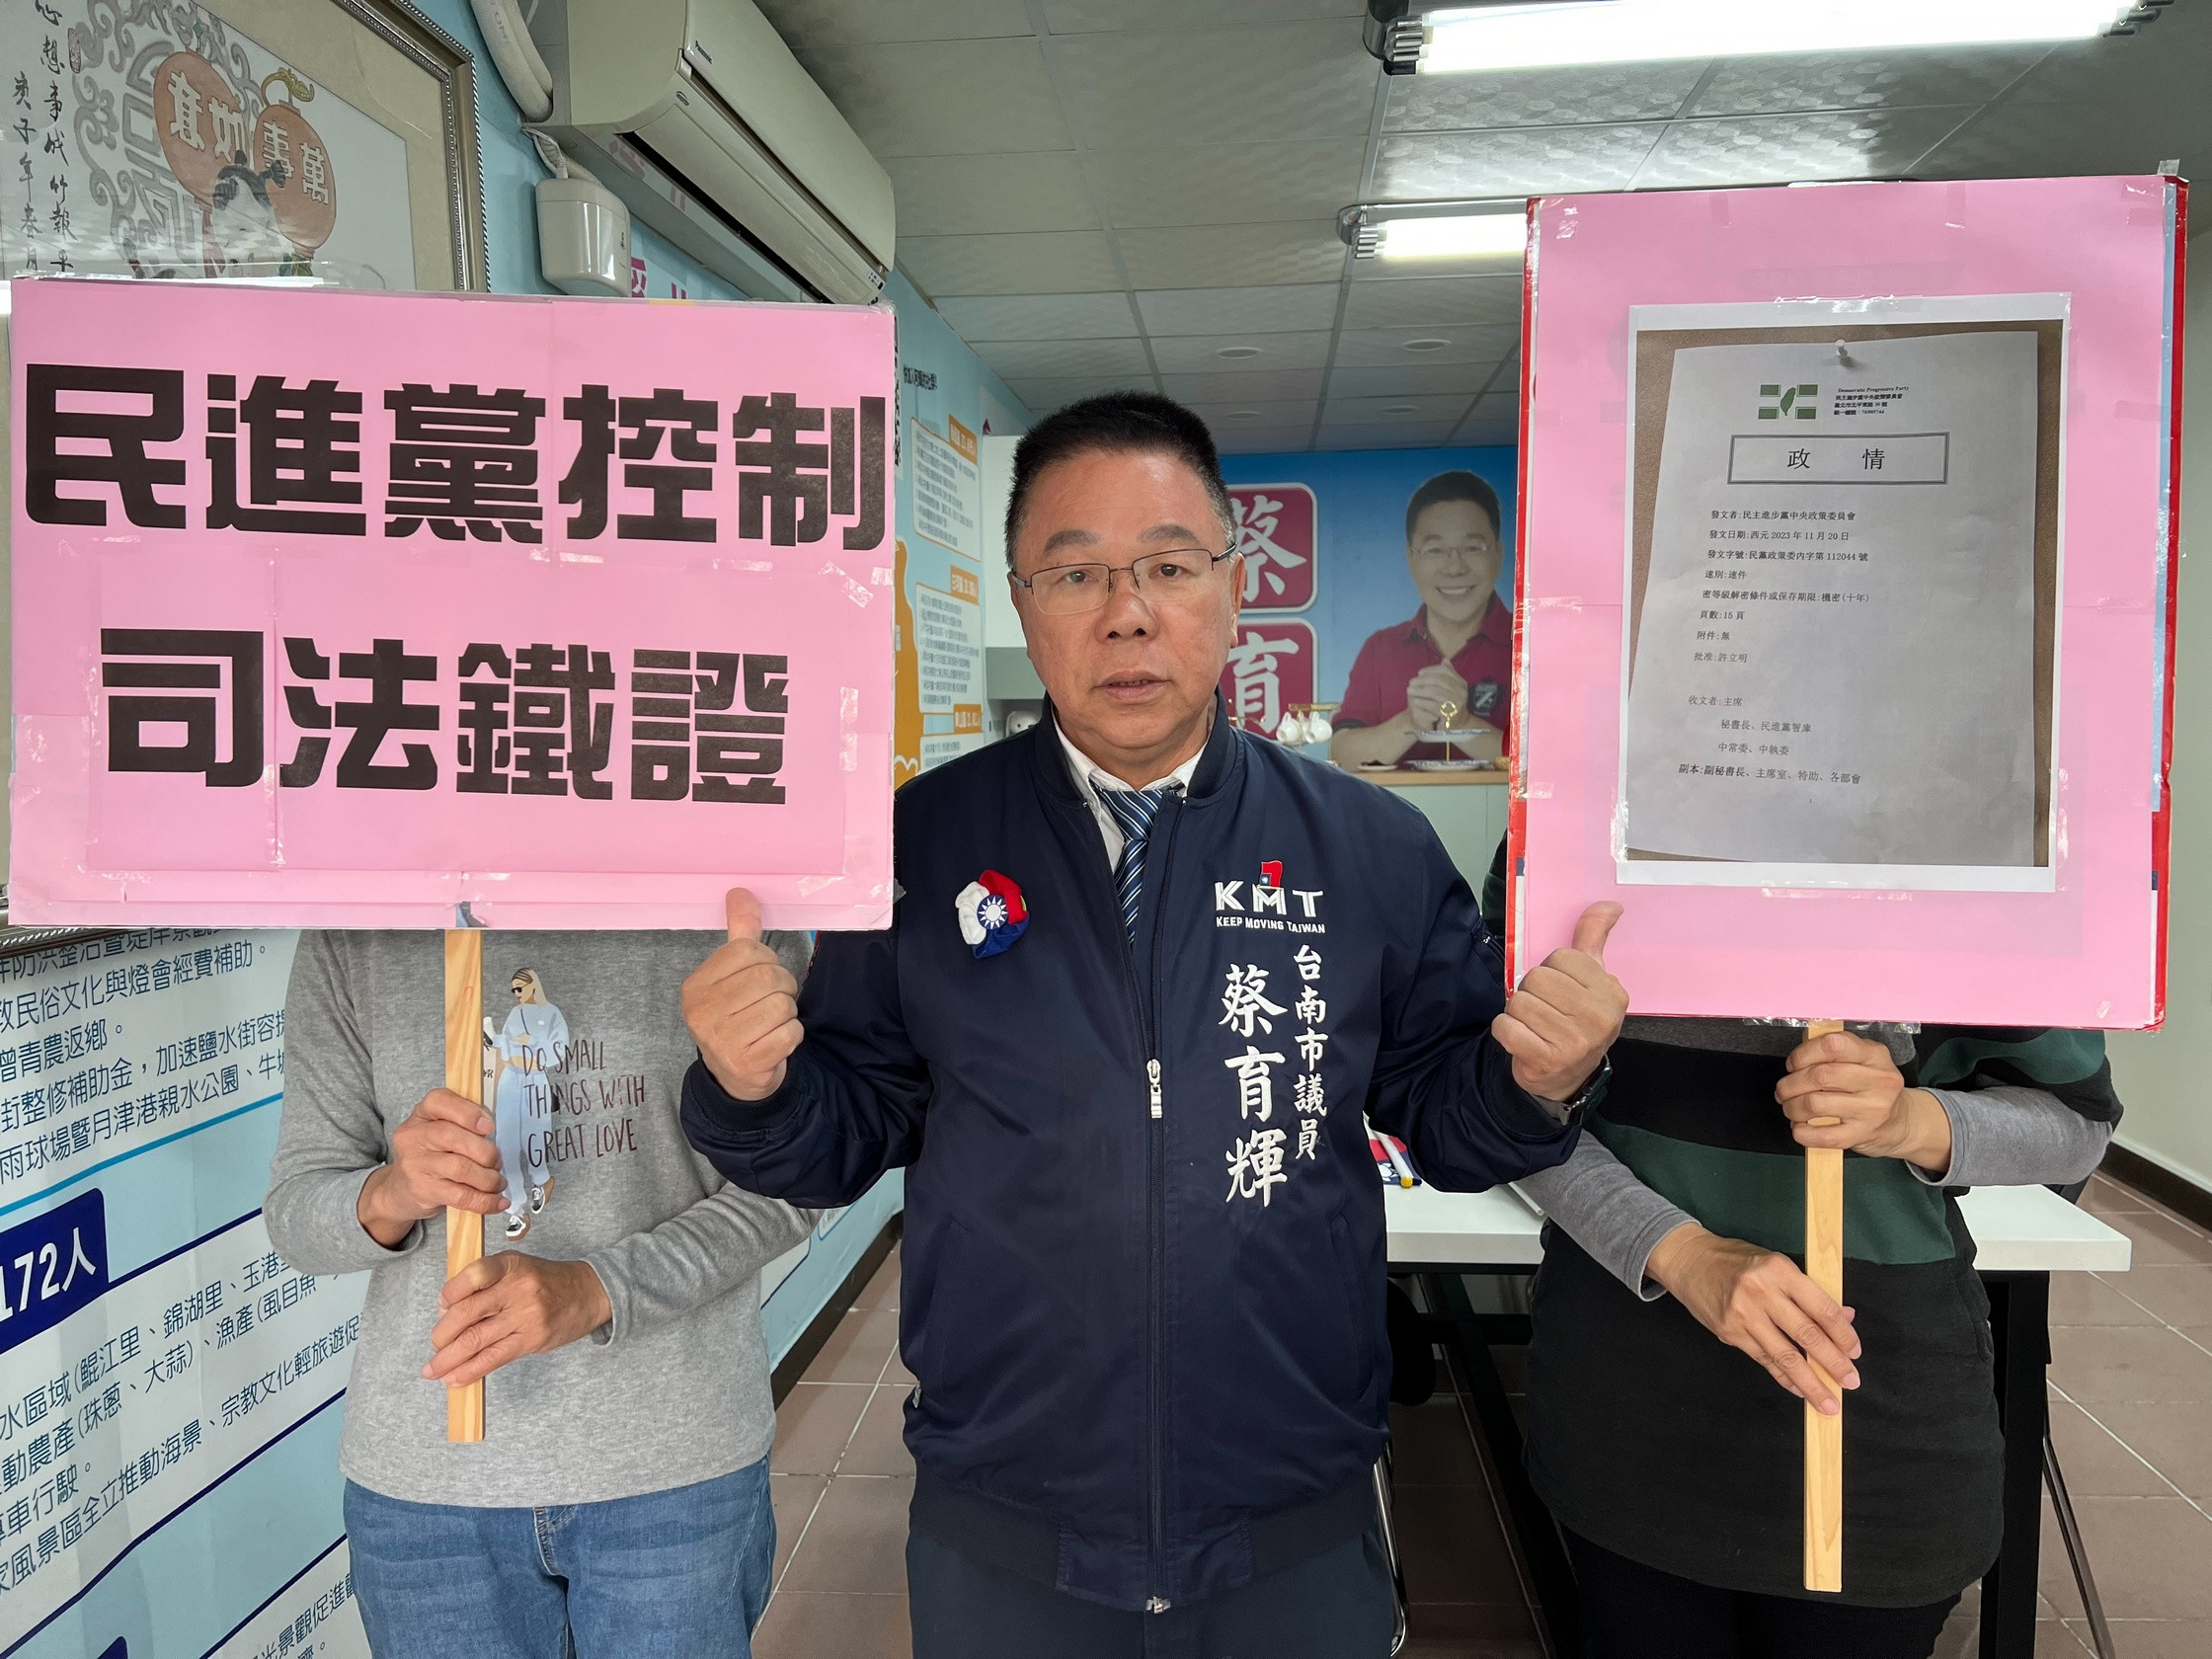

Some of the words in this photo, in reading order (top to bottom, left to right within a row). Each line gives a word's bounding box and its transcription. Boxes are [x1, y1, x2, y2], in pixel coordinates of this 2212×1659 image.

[25, 362, 887, 552] 民進黨控制
[100, 627, 790, 806] 司法鐵證
[1214, 880, 1324, 918] KMT
[1216, 915, 1243, 928] KEEP
[1244, 916, 1285, 931] MOVING
[1286, 919, 1326, 934] TAIWAN
[521, 1044, 547, 1077] DO
[552, 1038, 608, 1075] SMALL
[1293, 944, 1329, 1161] 台南市議員
[522, 1078, 592, 1119] THINGS
[599, 1073, 646, 1110] WITH
[1218, 963, 1289, 1209] 蔡育輝
[527, 1123, 587, 1168] GREAT
[595, 1117, 639, 1158] LOVE
